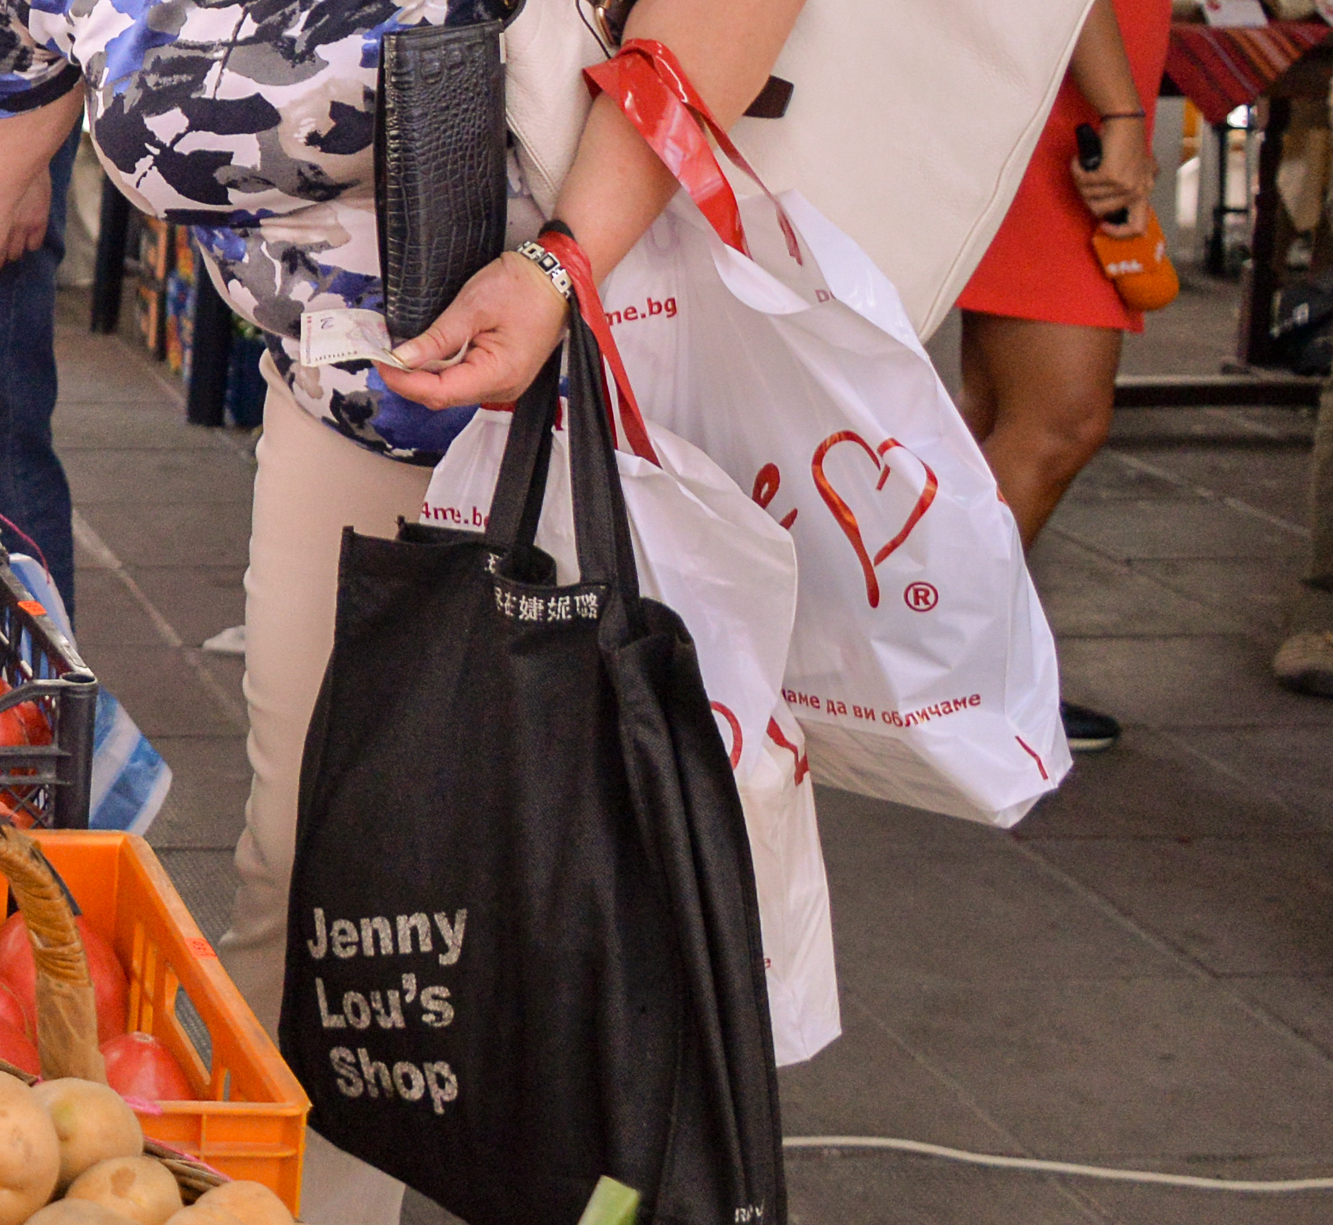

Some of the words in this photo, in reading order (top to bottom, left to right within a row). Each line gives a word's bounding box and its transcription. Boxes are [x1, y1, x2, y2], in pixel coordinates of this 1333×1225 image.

[603, 297, 677, 326] me.bg
[826, 698, 848, 716] да
[851, 703, 877, 721] ви
[881, 693, 982, 727] обличаме
[307, 907, 468, 965] Jenny
[315, 973, 455, 1029] Lou's
[329, 1046, 458, 1115] Shop
